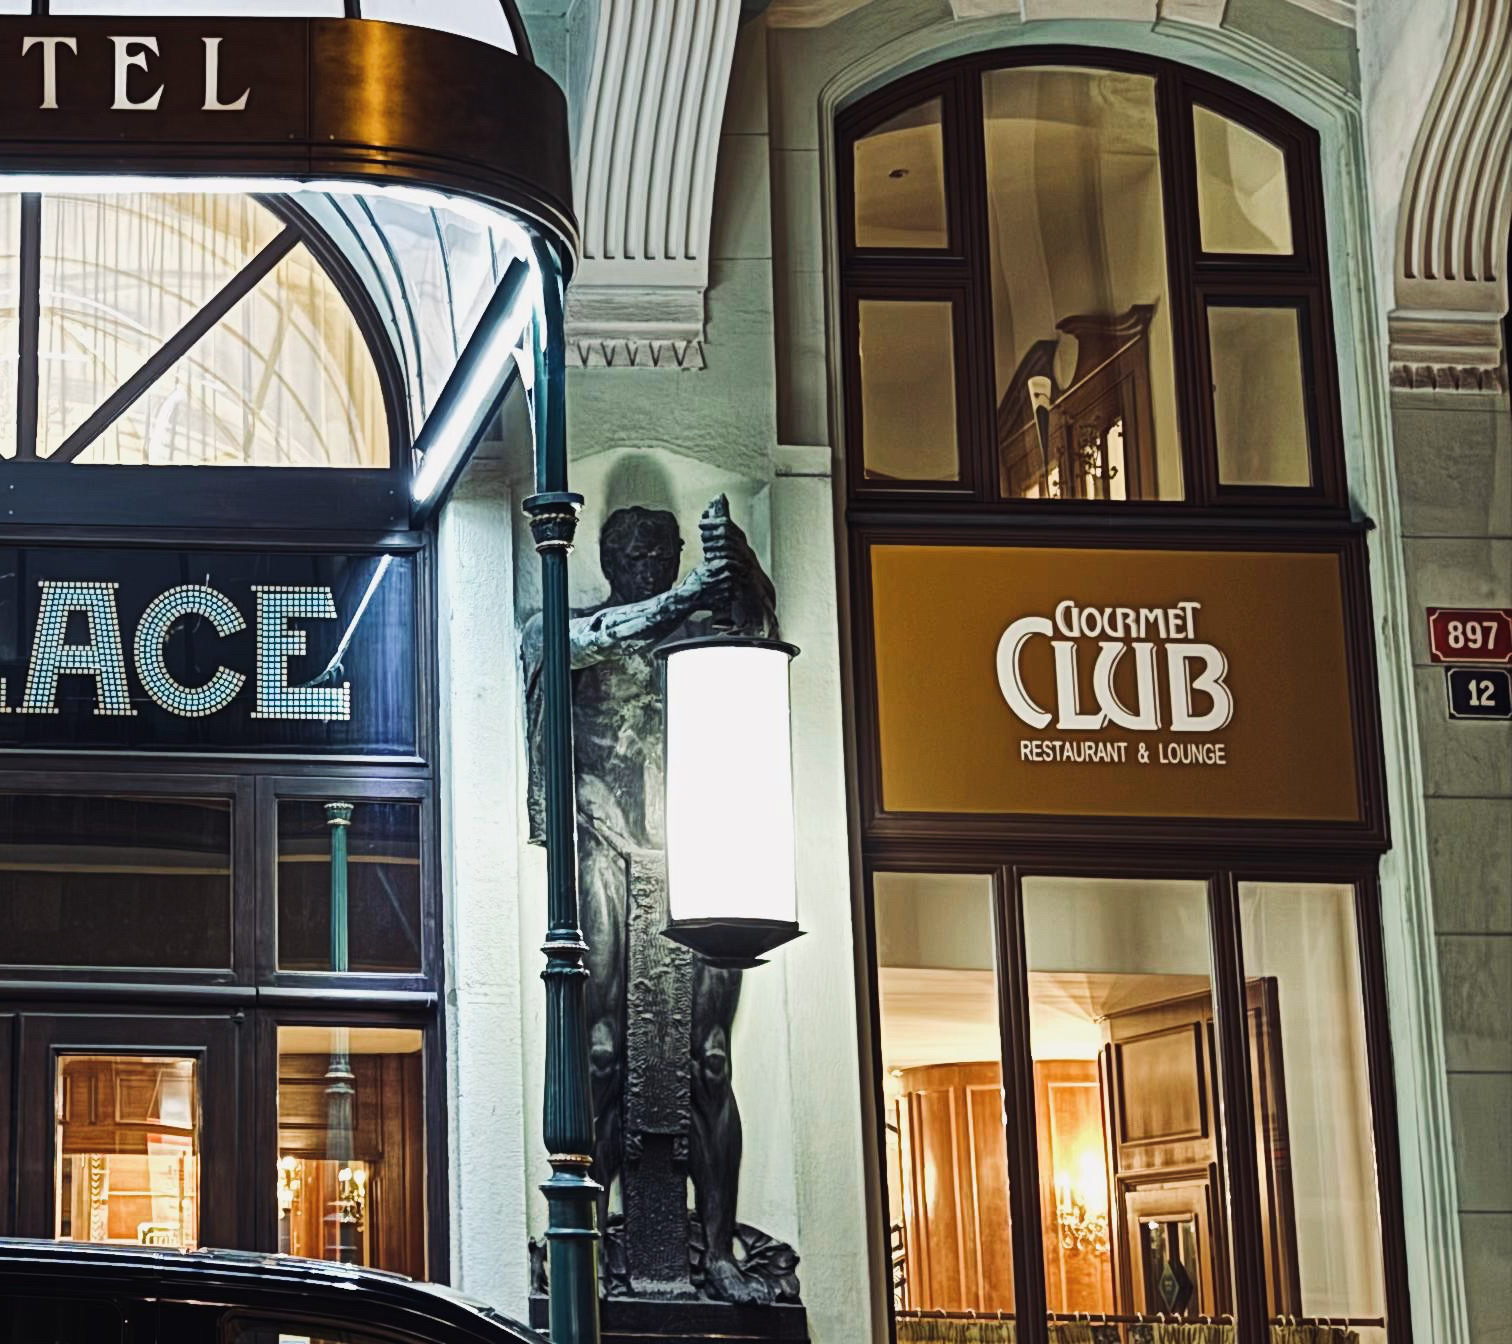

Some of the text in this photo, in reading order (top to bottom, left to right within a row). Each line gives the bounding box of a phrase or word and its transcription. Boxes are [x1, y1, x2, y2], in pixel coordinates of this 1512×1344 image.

[1054, 599, 1202, 640] GOURMET
[1447, 620, 1498, 650] 897
[996, 616, 1234, 732] CLUB
[1468, 679, 1496, 706] 12
[1019, 739, 1228, 765] RESTAURANT & LOUNGE
